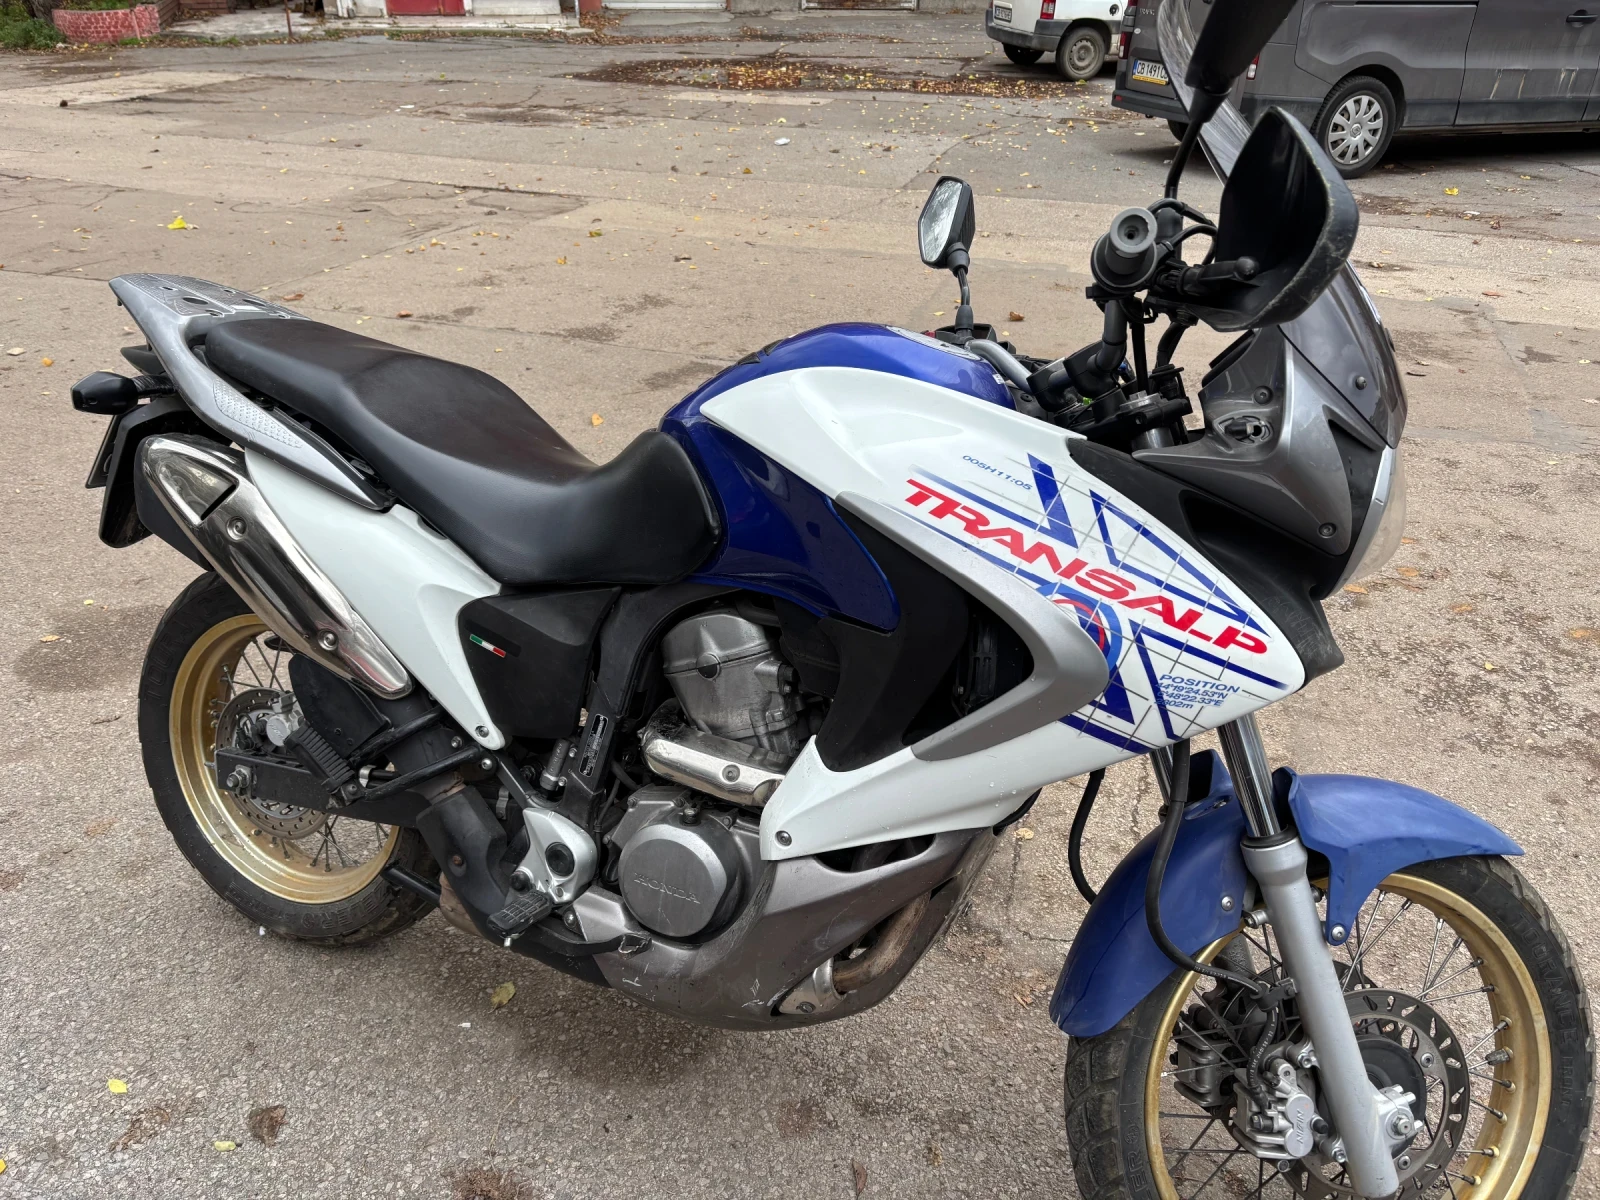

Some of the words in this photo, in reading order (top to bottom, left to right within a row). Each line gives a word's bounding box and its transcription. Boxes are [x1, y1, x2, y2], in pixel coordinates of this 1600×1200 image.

[1146, 64, 1160, 78] 1491
[905, 478, 1268, 654] TRANSALP
[1159, 674, 1240, 693] POSITION
[633, 872, 701, 904] HONDA
